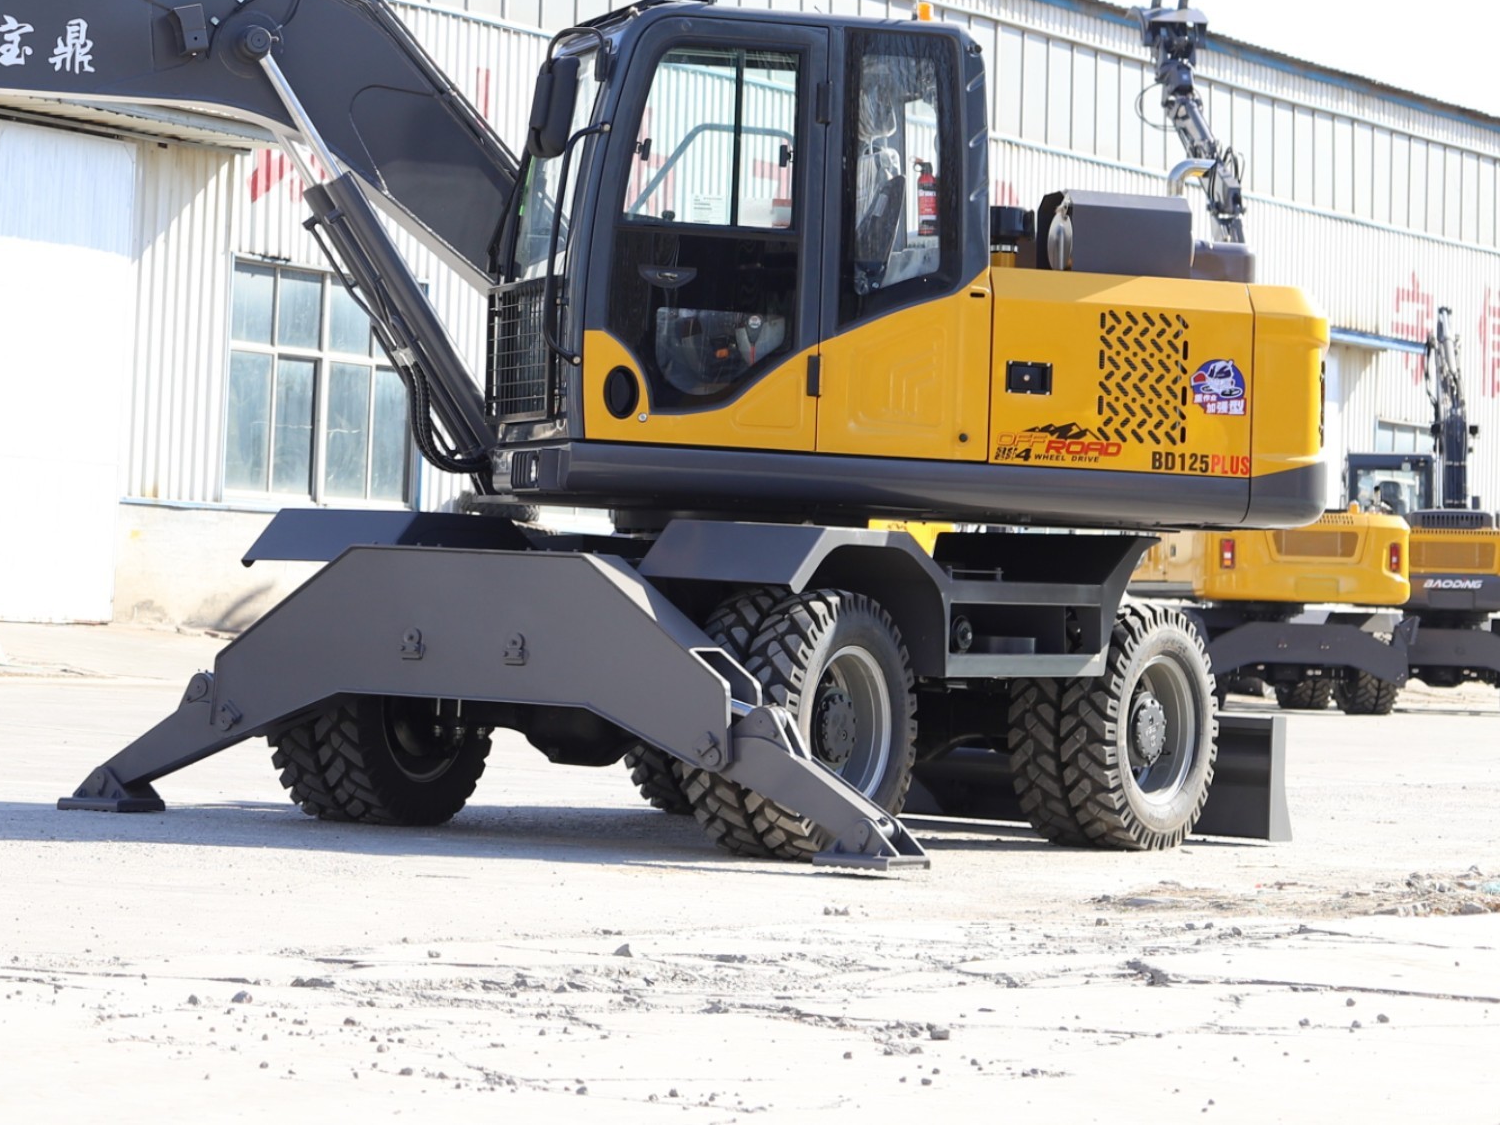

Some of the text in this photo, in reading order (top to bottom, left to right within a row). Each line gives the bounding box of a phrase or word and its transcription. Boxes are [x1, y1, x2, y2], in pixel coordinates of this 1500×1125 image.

[997, 432, 1122, 458] OFF ROAD
[1034, 453, 1067, 462] WHEEL
[1071, 455, 1100, 464] DRIVE
[1423, 578, 1484, 590] BAODING
